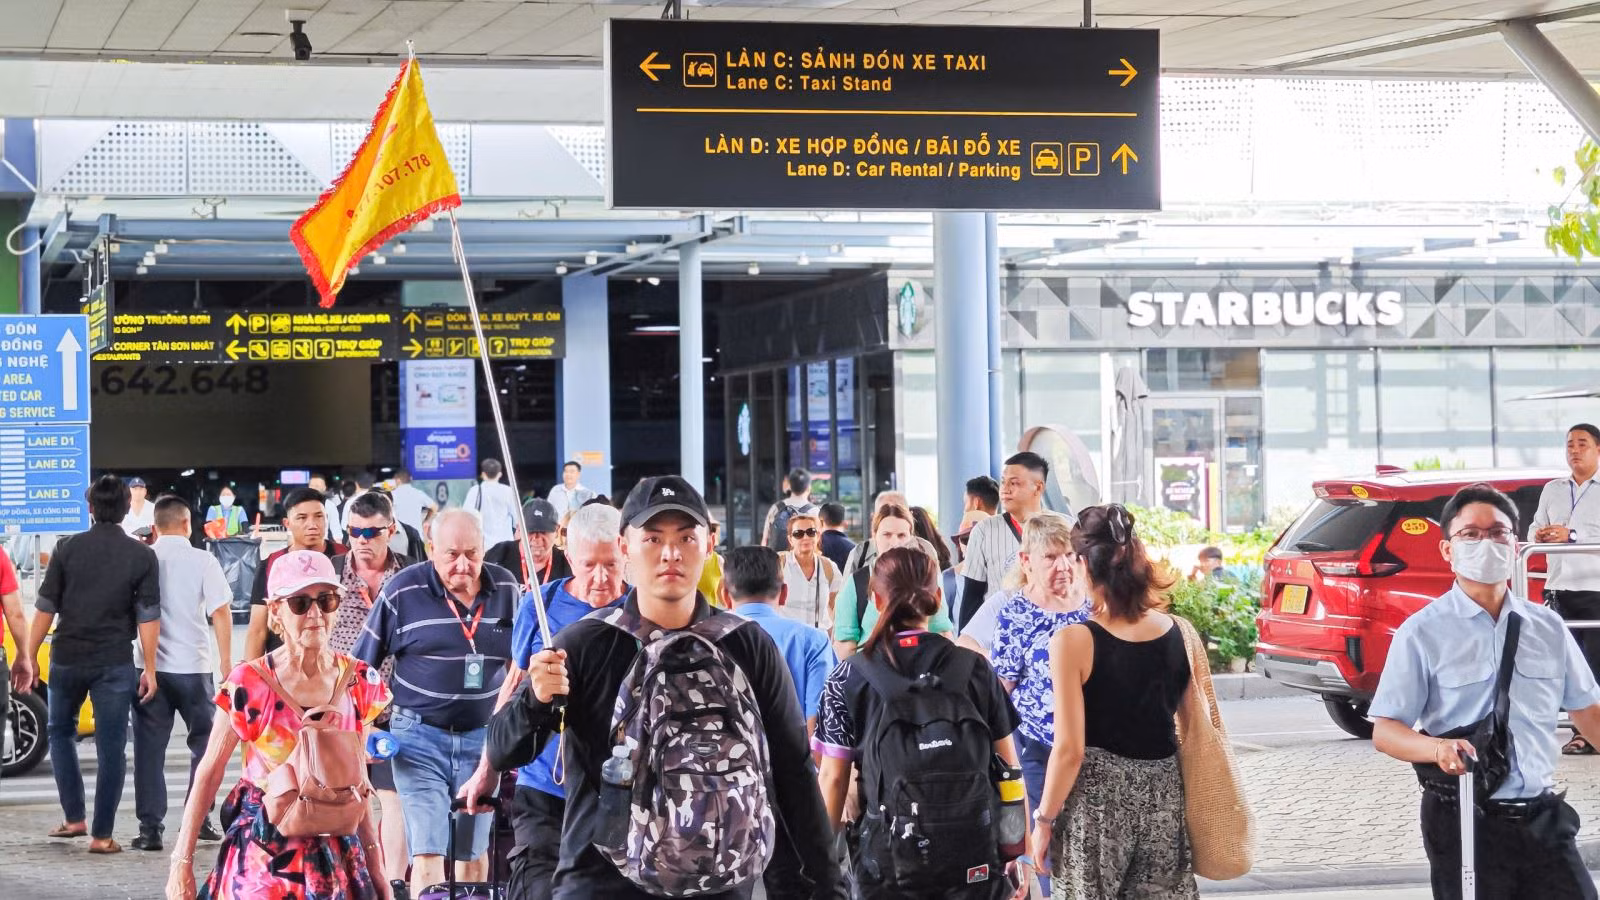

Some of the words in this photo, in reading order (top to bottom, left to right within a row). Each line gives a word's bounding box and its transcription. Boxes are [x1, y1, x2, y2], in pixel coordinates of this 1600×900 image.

[726, 48, 766, 68] LÀN
[773, 51, 794, 69] C:
[801, 47, 855, 70] SẢNH
[863, 50, 905, 70] ĐÓN
[912, 54, 936, 70] XE
[944, 54, 987, 71] TAXI
[726, 75, 769, 90] Lane
[775, 75, 794, 90] C:
[800, 75, 836, 91] Taxi
[842, 75, 892, 92] Stand
[705, 134, 744, 154] LÀN
[750, 139, 770, 154] D:
[776, 137, 801, 155] XE
[807, 136, 848, 158] HỢP
[853, 132, 909, 156] ĐỒNG
[927, 134, 958, 156] BÃI
[964, 131, 991, 156] ĐỖ
[997, 139, 1021, 156] XE
[787, 161, 828, 178] Lane
[833, 161, 851, 177] D:
[856, 161, 885, 178] Car
[891, 161, 943, 179] Rental
[958, 161, 1022, 183] Parking
[1128, 291, 1405, 327] STARBUCKS
[469, 313, 490, 323] TXI,
[5, 321, 38, 336] ĐÓN
[7, 353, 49, 369] NGHỆ
[3, 373, 33, 385] AREA
[0, 389, 17, 402] ED
[20, 389, 43, 402] CAR
[9, 406, 56, 419] SERVICE
[27, 436, 59, 447] LANE
[60, 436, 75, 447] D1
[28, 459, 59, 469] LANE
[61, 458, 76, 469] D2
[29, 489, 60, 499] LANE
[61, 488, 71, 499] D
[1404, 522, 1427, 531] 259
